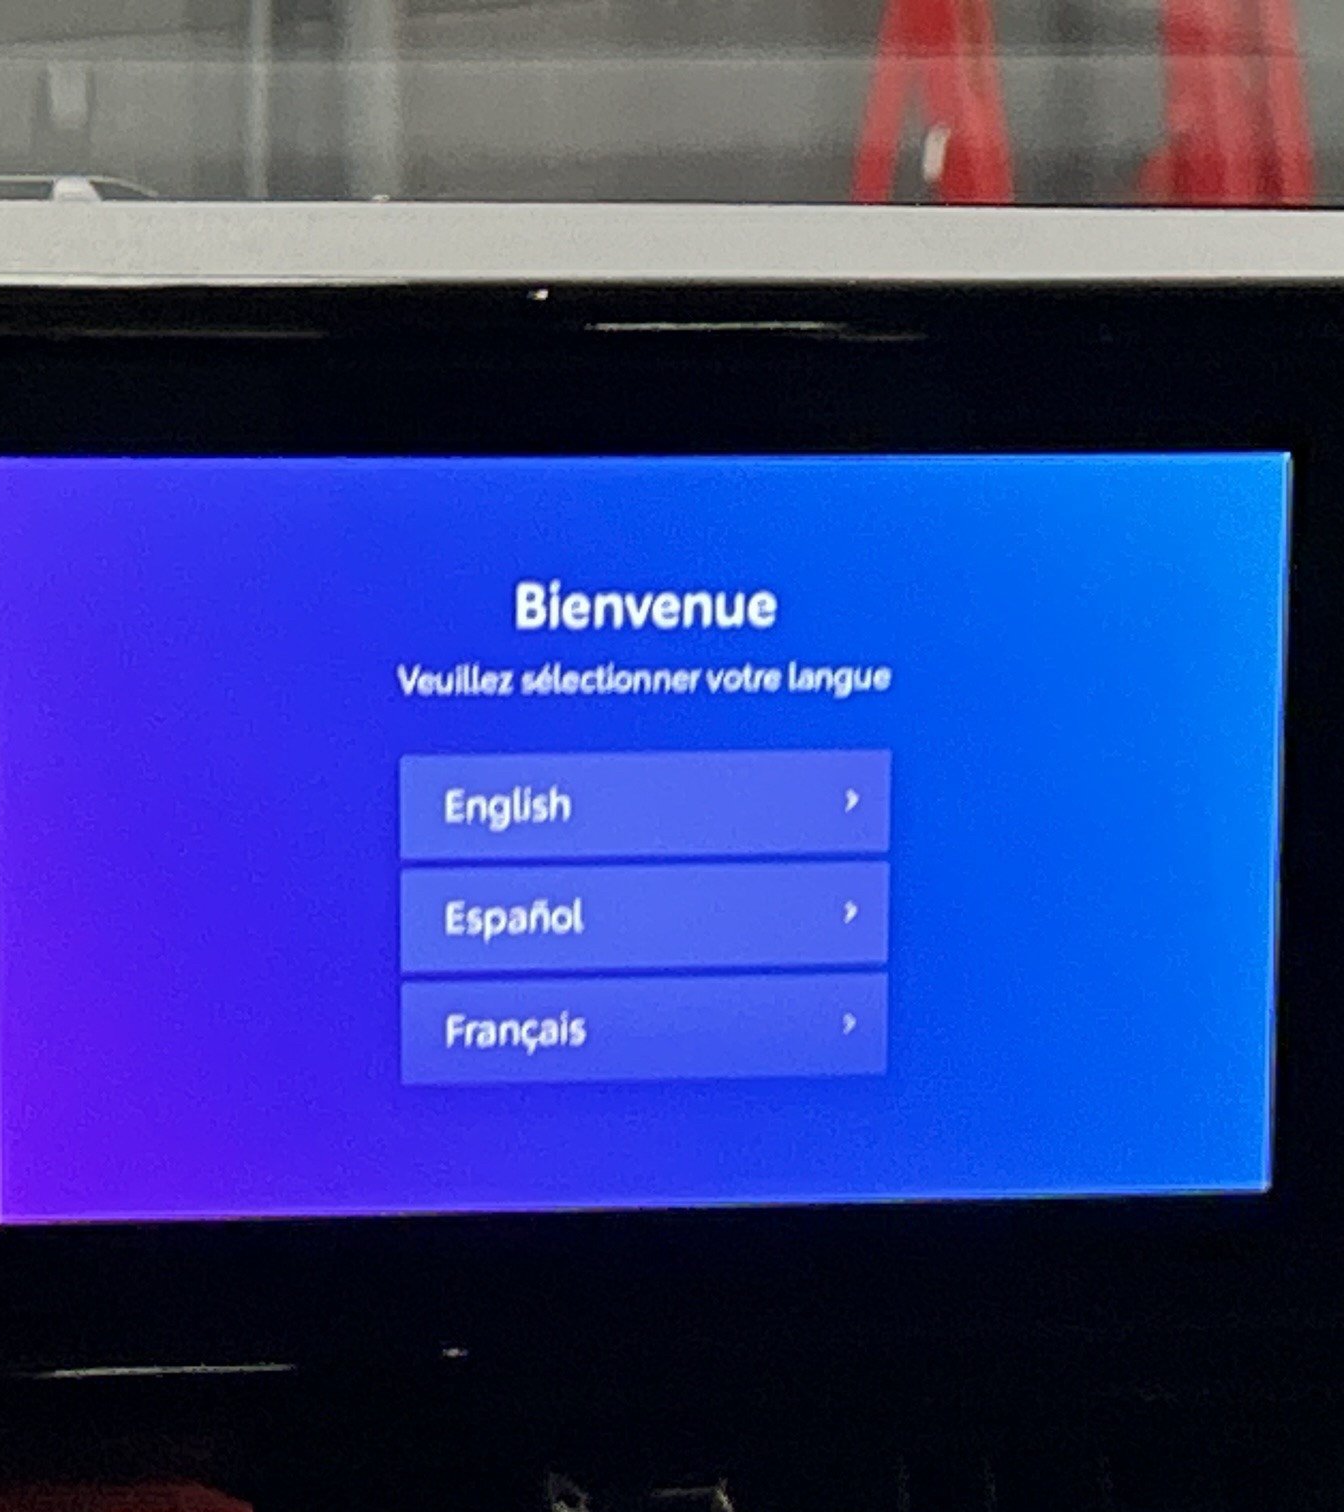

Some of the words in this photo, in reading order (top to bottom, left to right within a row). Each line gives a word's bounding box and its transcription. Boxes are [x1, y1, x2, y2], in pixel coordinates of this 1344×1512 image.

[515, 579, 777, 630] Bienvenue
[396, 662, 515, 697] Veuillez
[520, 660, 702, 695] sélectionner
[706, 661, 782, 694] votre
[788, 660, 893, 699] langue
[444, 786, 573, 832] English
[444, 898, 585, 944] Español
[444, 1011, 587, 1056] Français
